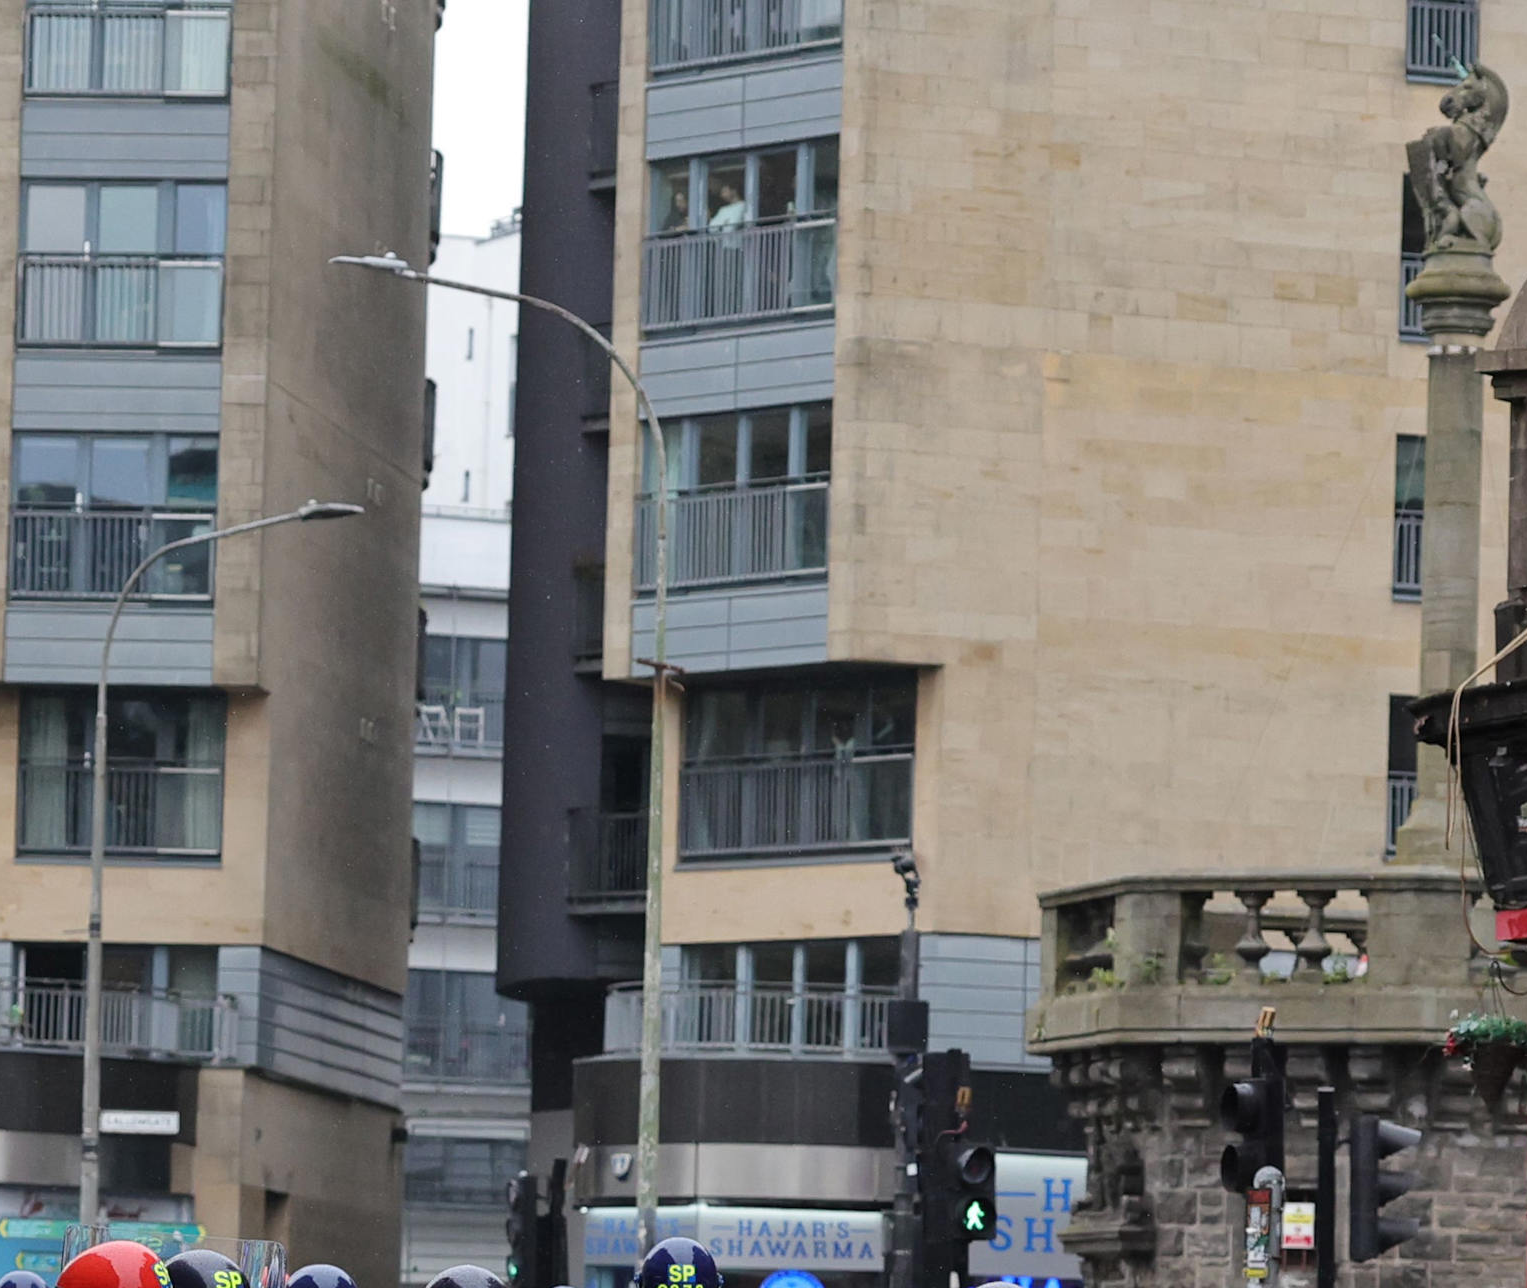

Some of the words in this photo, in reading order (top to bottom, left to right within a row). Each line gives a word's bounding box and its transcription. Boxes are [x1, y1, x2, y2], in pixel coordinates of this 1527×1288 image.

[737, 1219, 850, 1238] HAJAR'S
[710, 1237, 875, 1259] SHAWARMA
[669, 1264, 696, 1283] SP
